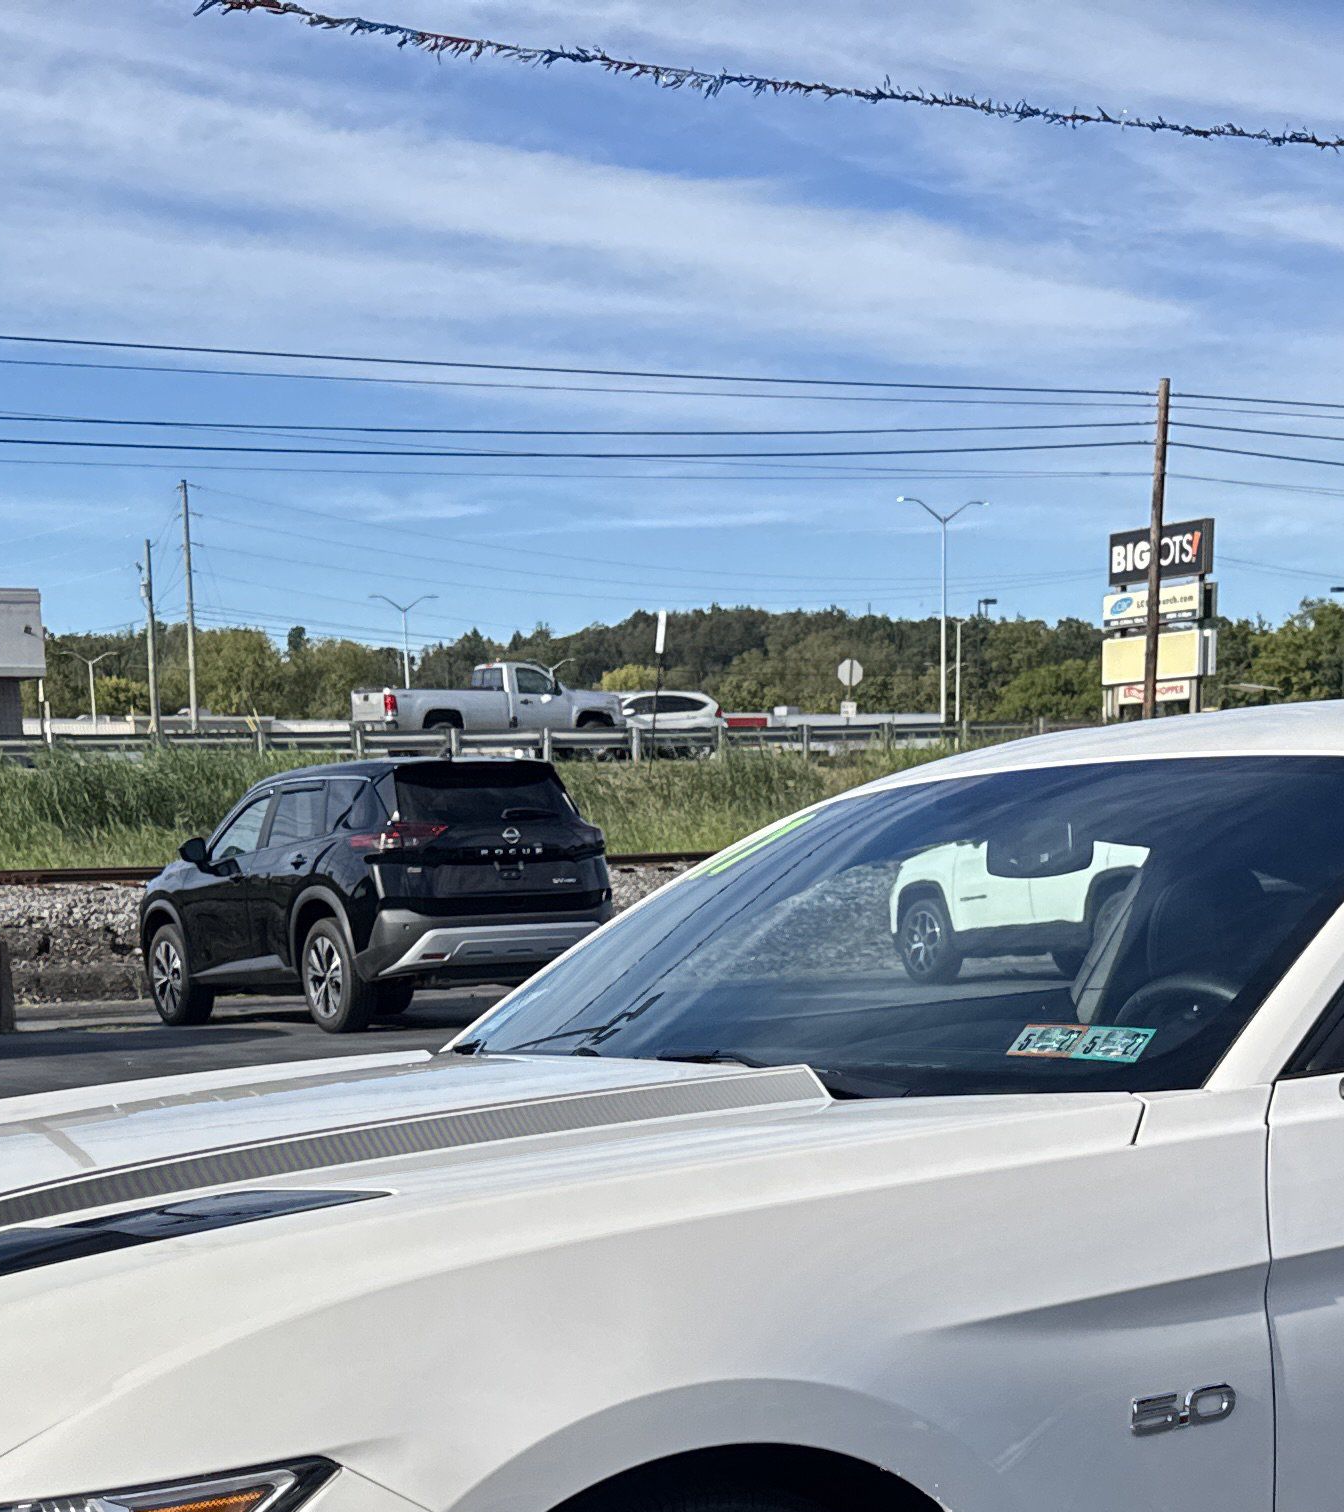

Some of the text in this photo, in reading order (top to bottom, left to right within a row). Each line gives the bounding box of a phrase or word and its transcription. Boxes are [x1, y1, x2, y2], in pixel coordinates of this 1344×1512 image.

[1112, 530, 1202, 574] BIG OTS!
[1018, 1033, 1036, 1051] 5
[1083, 1035, 1101, 1055] 5
[1131, 1382, 1236, 1437] 5.0
